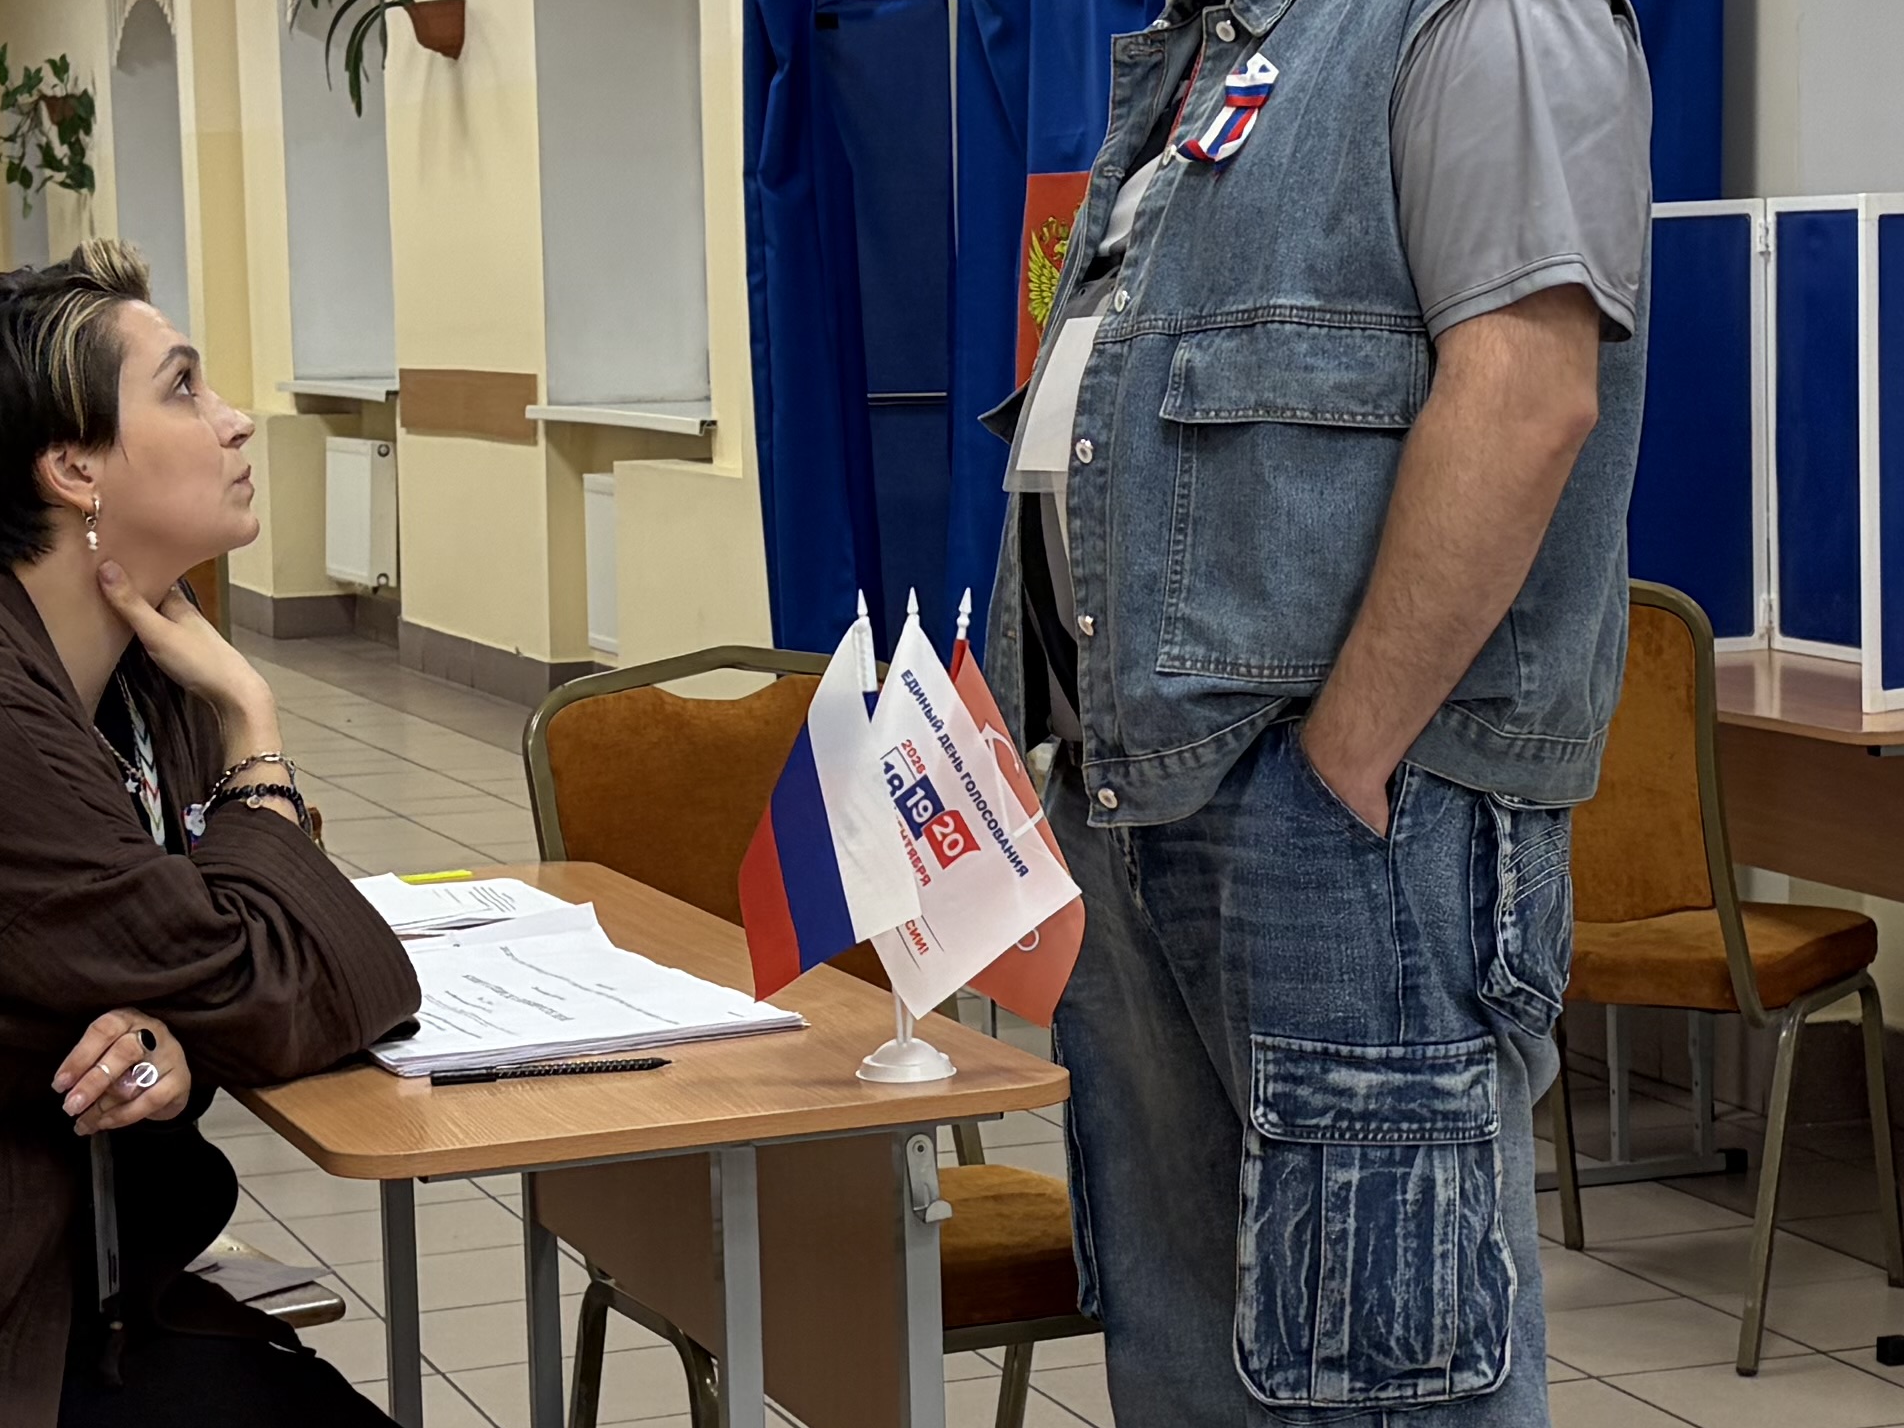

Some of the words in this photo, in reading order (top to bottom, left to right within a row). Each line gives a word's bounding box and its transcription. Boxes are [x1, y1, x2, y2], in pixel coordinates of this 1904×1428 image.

[901, 739, 927, 775] 2026
[901, 669, 944, 733] ЕДИНЫЙ
[937, 733, 964, 773] ДЕНЬ
[960, 772, 1030, 878] ГОЛОСОВАНИЯ
[906, 787, 934, 823] 19
[932, 815, 964, 857] 20
